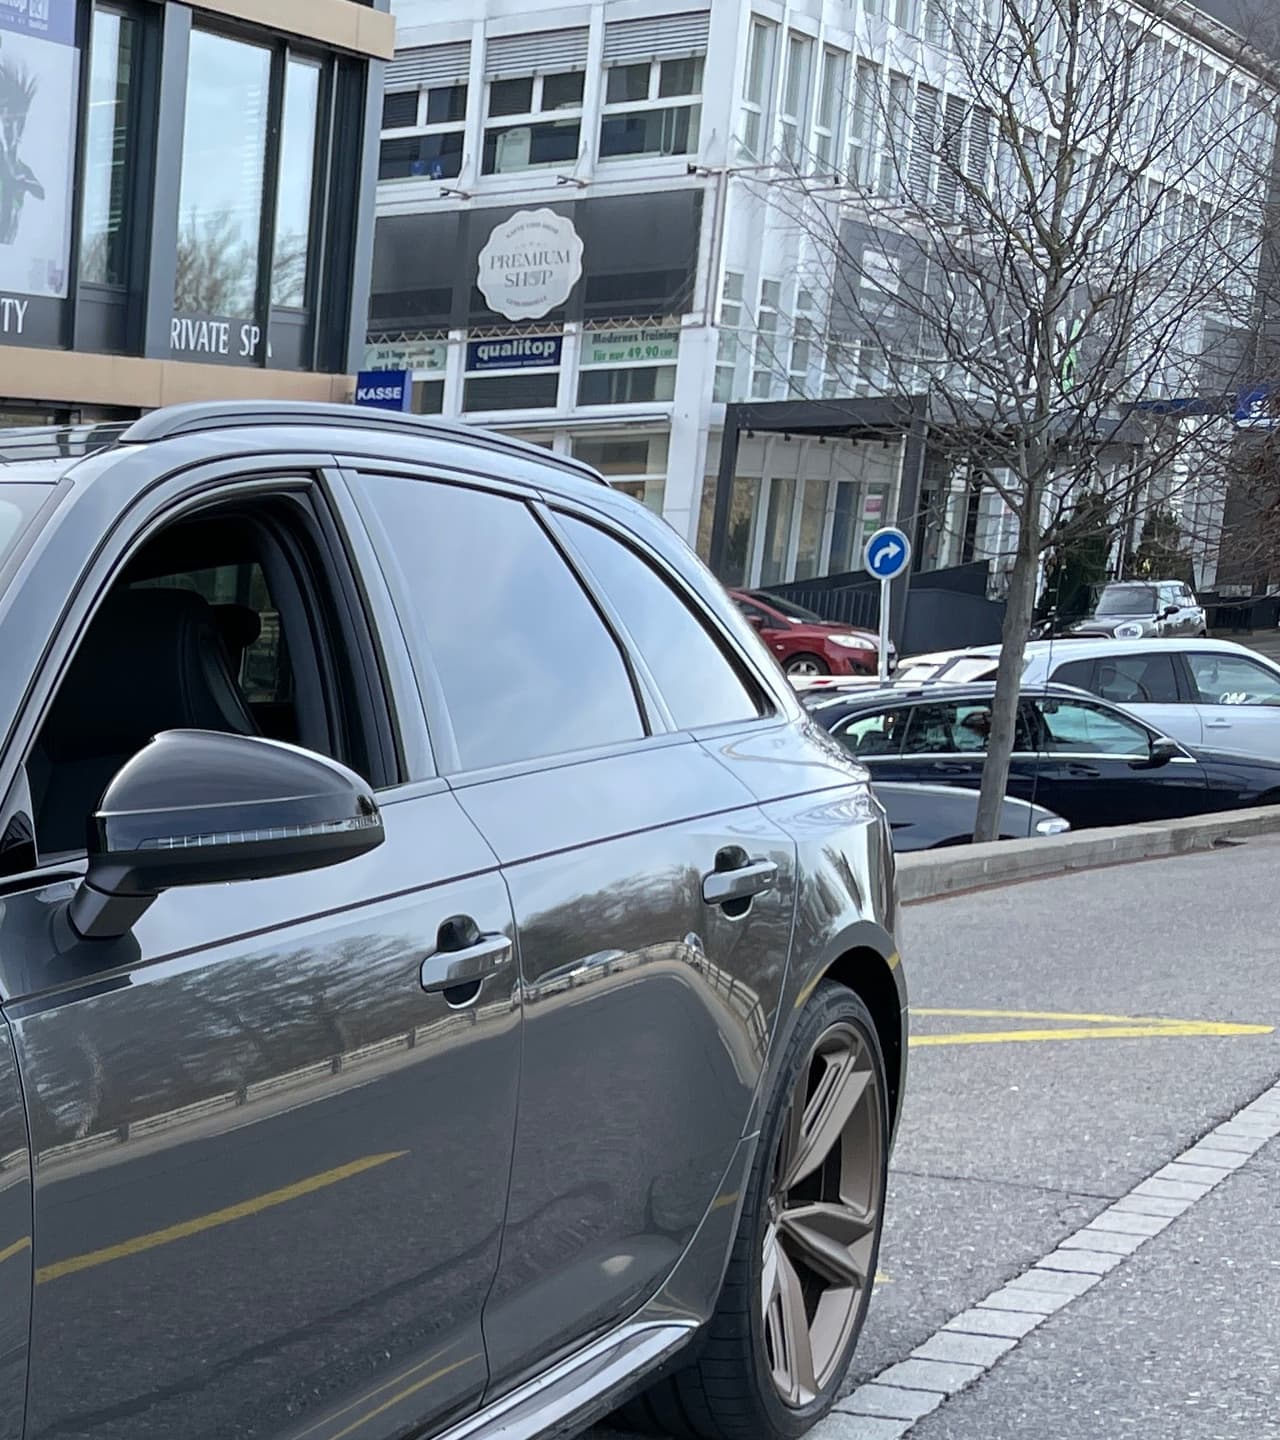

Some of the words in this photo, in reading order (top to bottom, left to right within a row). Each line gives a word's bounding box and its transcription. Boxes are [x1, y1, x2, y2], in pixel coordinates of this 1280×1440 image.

[490, 250, 570, 270] PREMIUM
[240, 324, 273, 358] SP
[477, 340, 557, 361] qualitop
[357, 387, 402, 401] KASSE
